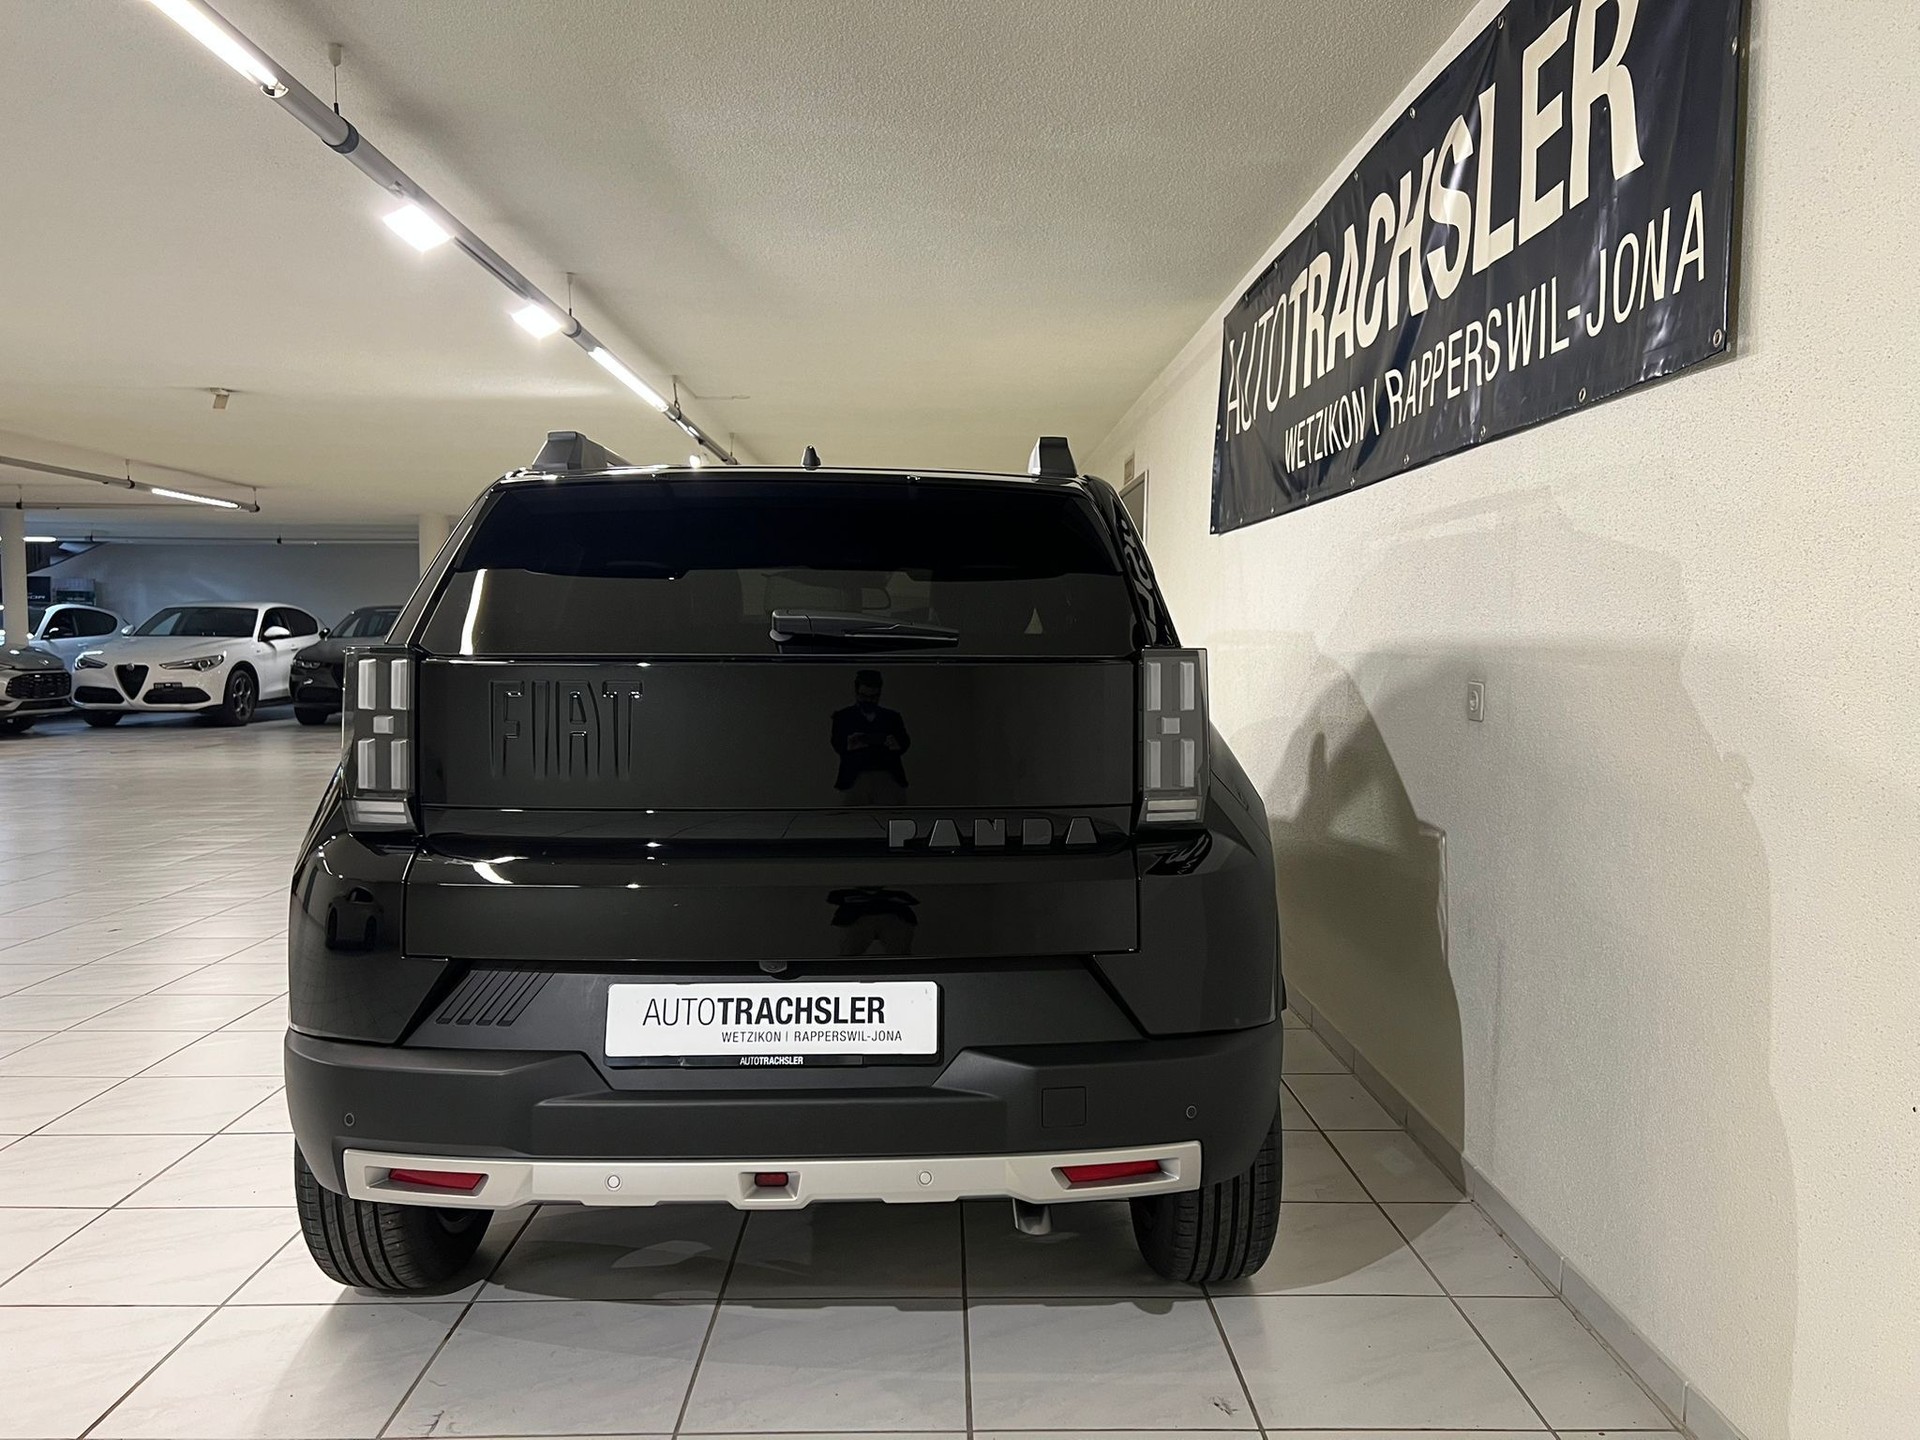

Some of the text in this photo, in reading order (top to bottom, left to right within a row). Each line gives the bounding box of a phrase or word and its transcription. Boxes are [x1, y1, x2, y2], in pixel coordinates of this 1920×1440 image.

[1226, 0, 1644, 442] AUTOTRACHSLER
[1284, 385, 1366, 474] WETZIKON
[1385, 190, 1706, 430] RAPPERSWIL-JONA
[488, 679, 643, 779] FIAT
[888, 816, 1098, 848] PANDA
[643, 996, 885, 1026] AUTOTRACHSLER
[721, 1031, 782, 1043] WETZIKON
[794, 1030, 903, 1042] RAPPERSWIL-JONA
[739, 1055, 804, 1066] AUTOTRACHSLER
